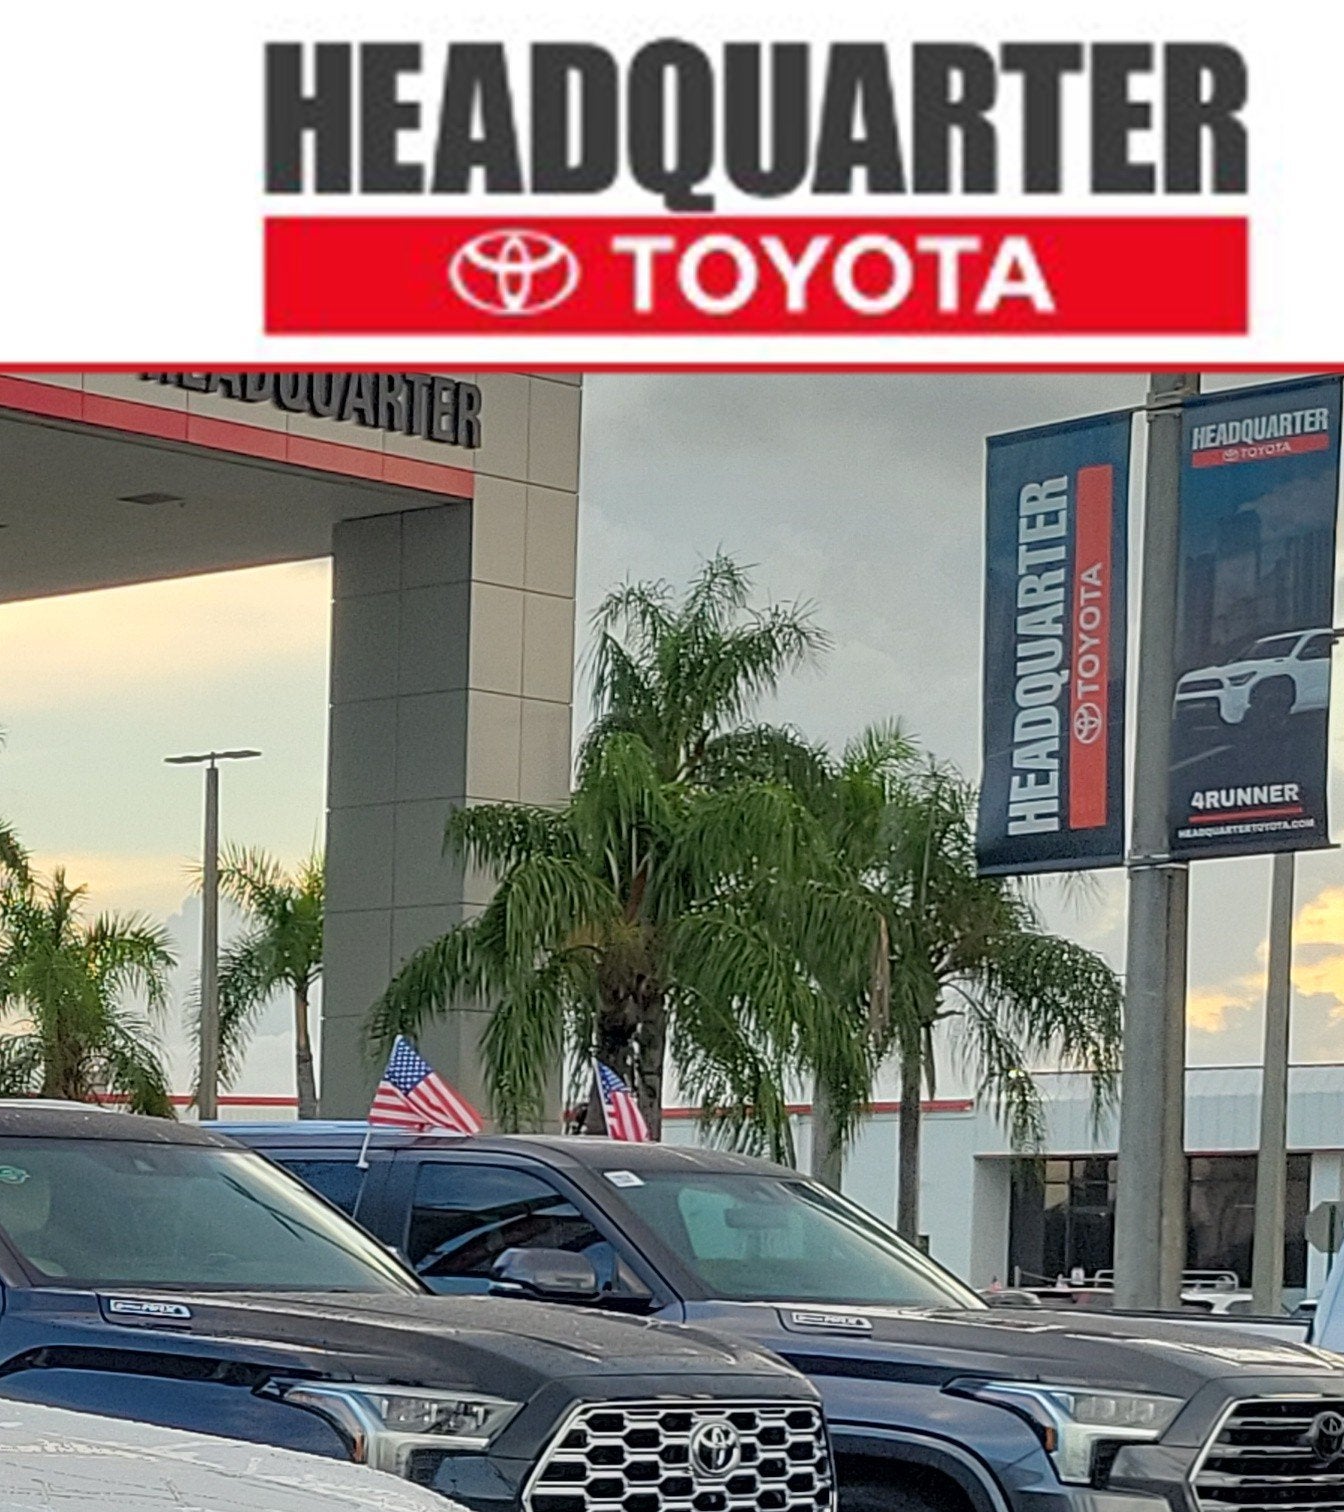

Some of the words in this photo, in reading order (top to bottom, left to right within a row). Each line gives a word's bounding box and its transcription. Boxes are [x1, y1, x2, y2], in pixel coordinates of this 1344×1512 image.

[1192, 407, 1329, 450] HEADQUARTER
[1241, 441, 1292, 459] TOYOTA
[1075, 561, 1103, 694] TOYOTA
[1007, 474, 1070, 836] HEADQUARTER
[1191, 783, 1300, 810] 4RUNNER
